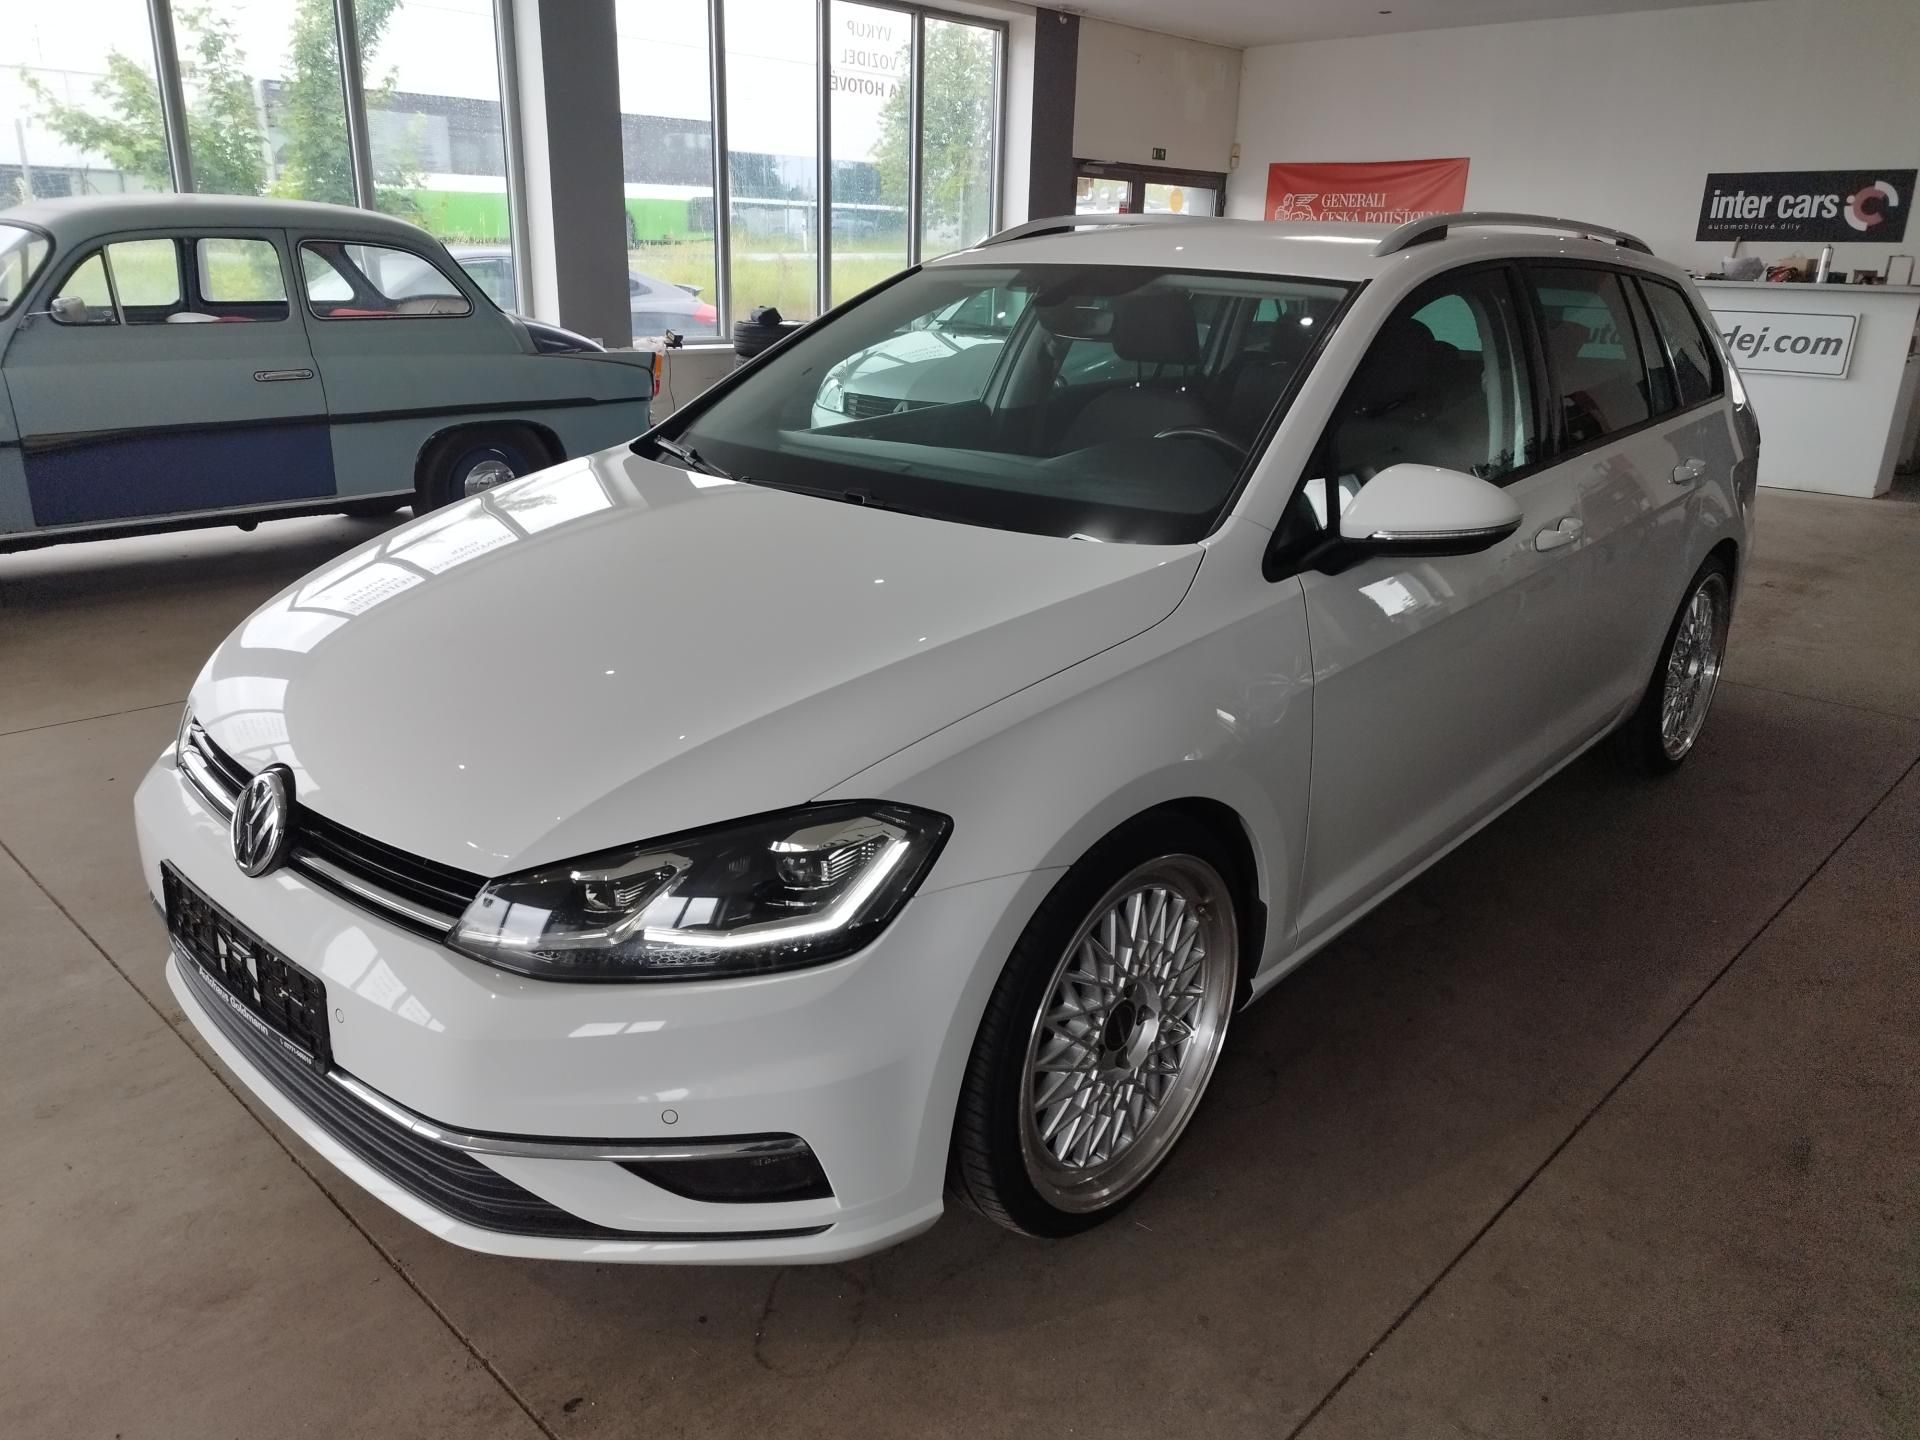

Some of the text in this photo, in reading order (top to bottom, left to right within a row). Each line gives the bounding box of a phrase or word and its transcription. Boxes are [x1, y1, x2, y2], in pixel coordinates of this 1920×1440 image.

[1319, 208, 1360, 223] ČESKÁ
[1321, 193, 1386, 208] GENERALI
[1709, 189, 1840, 219] inter cars
[1722, 324, 1844, 359] dej.com
[230, 996, 269, 1036] Goldmann
